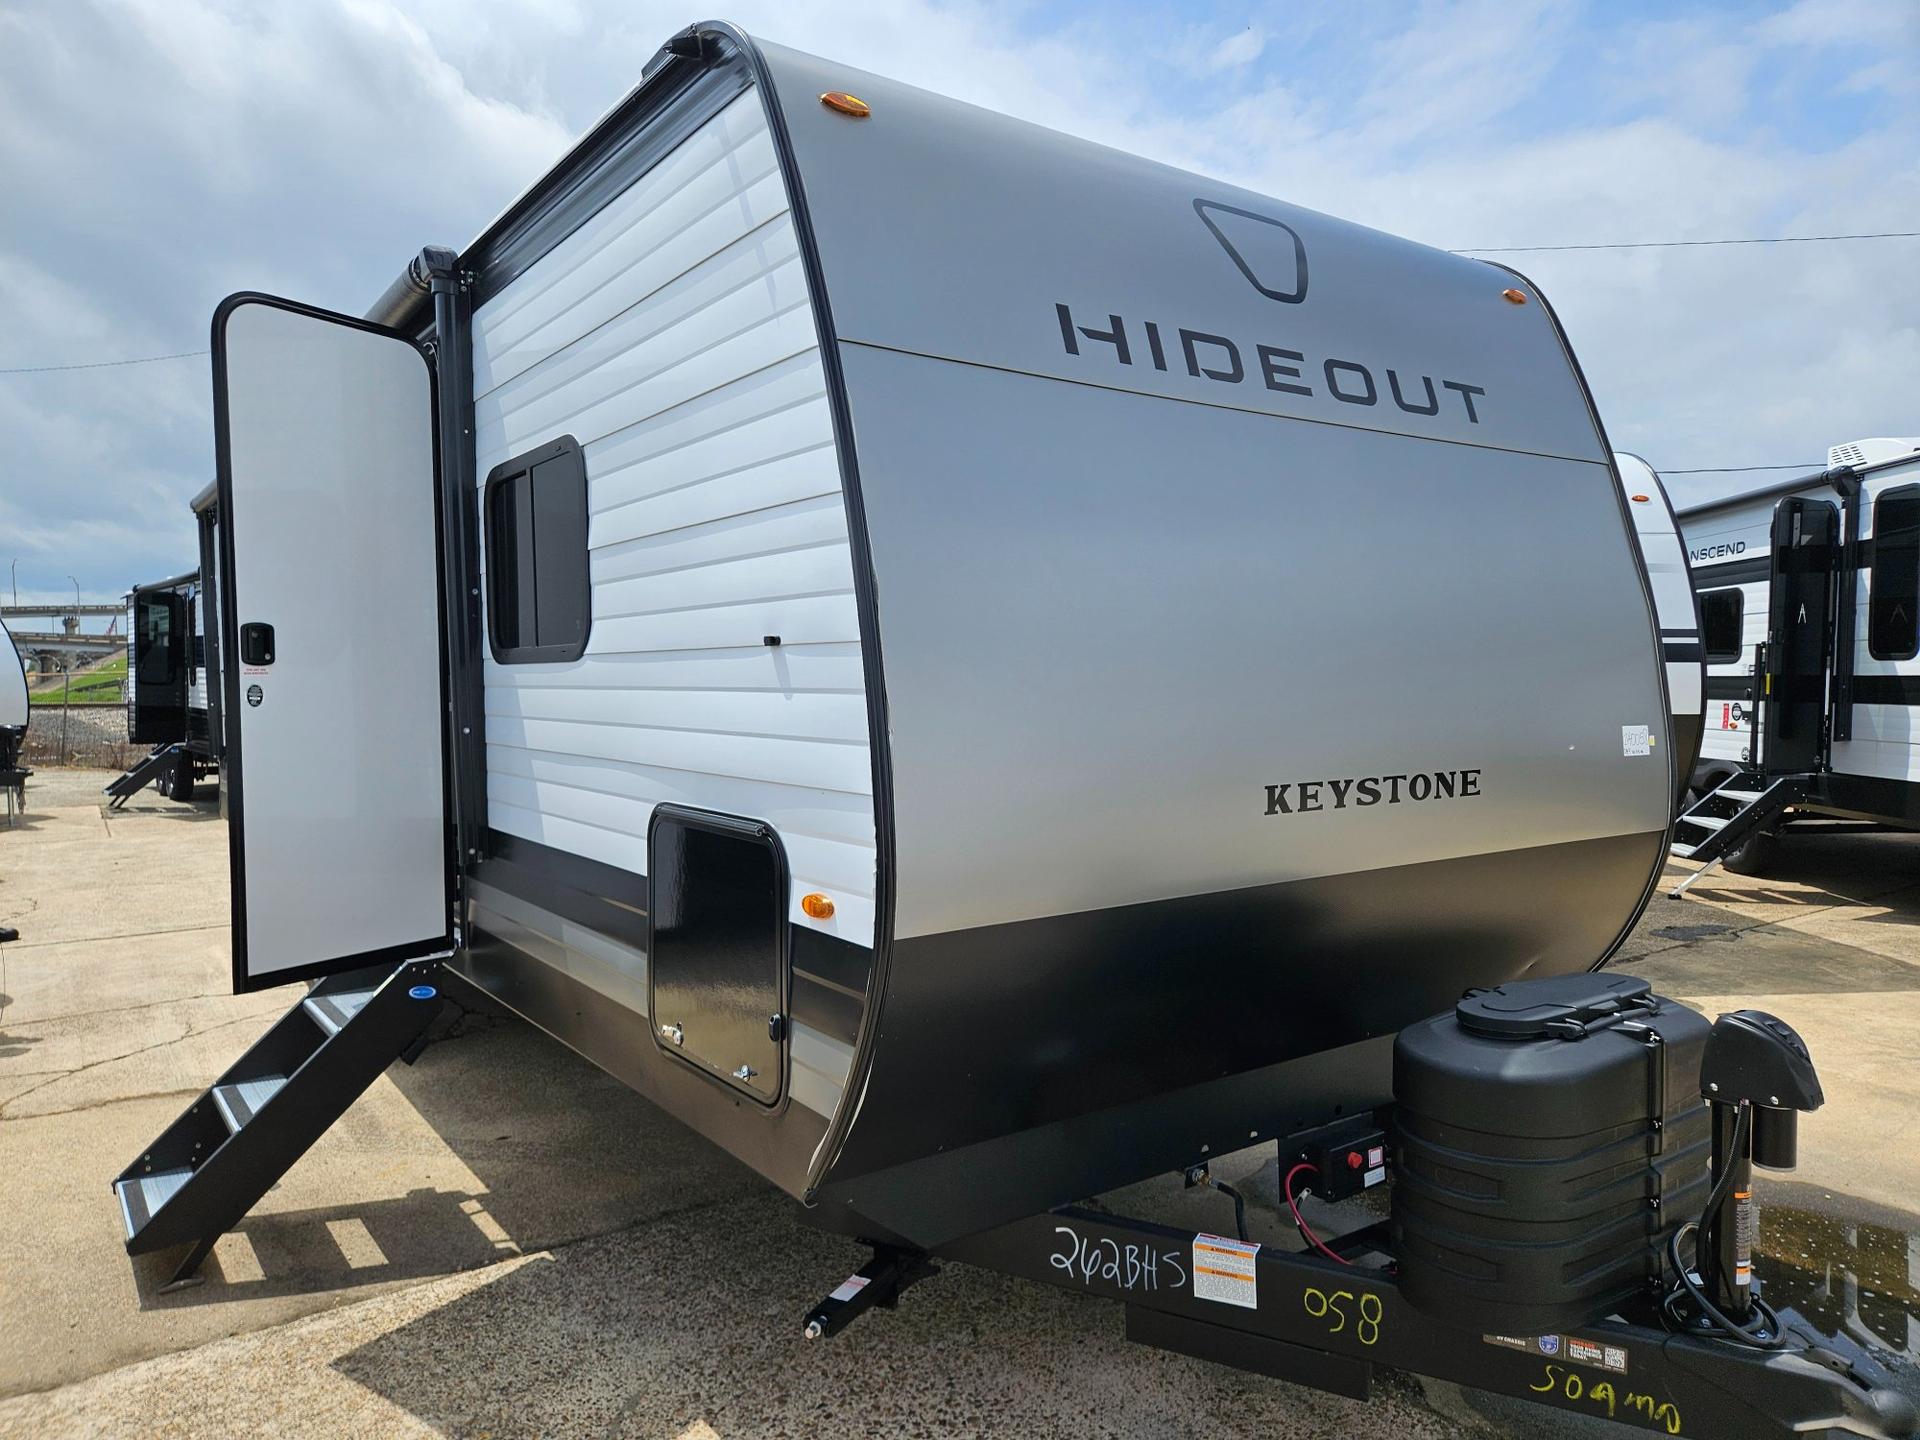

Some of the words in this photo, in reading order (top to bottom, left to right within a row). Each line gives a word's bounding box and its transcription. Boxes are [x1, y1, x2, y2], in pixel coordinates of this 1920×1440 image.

[1055, 302, 1486, 424] HIDEOUT
[1264, 769, 1481, 816] KEYSTONE
[1049, 1226, 1186, 1292] 262BHS
[1215, 1247, 1238, 1256] WARNING
[1304, 1287, 1383, 1345] 058
